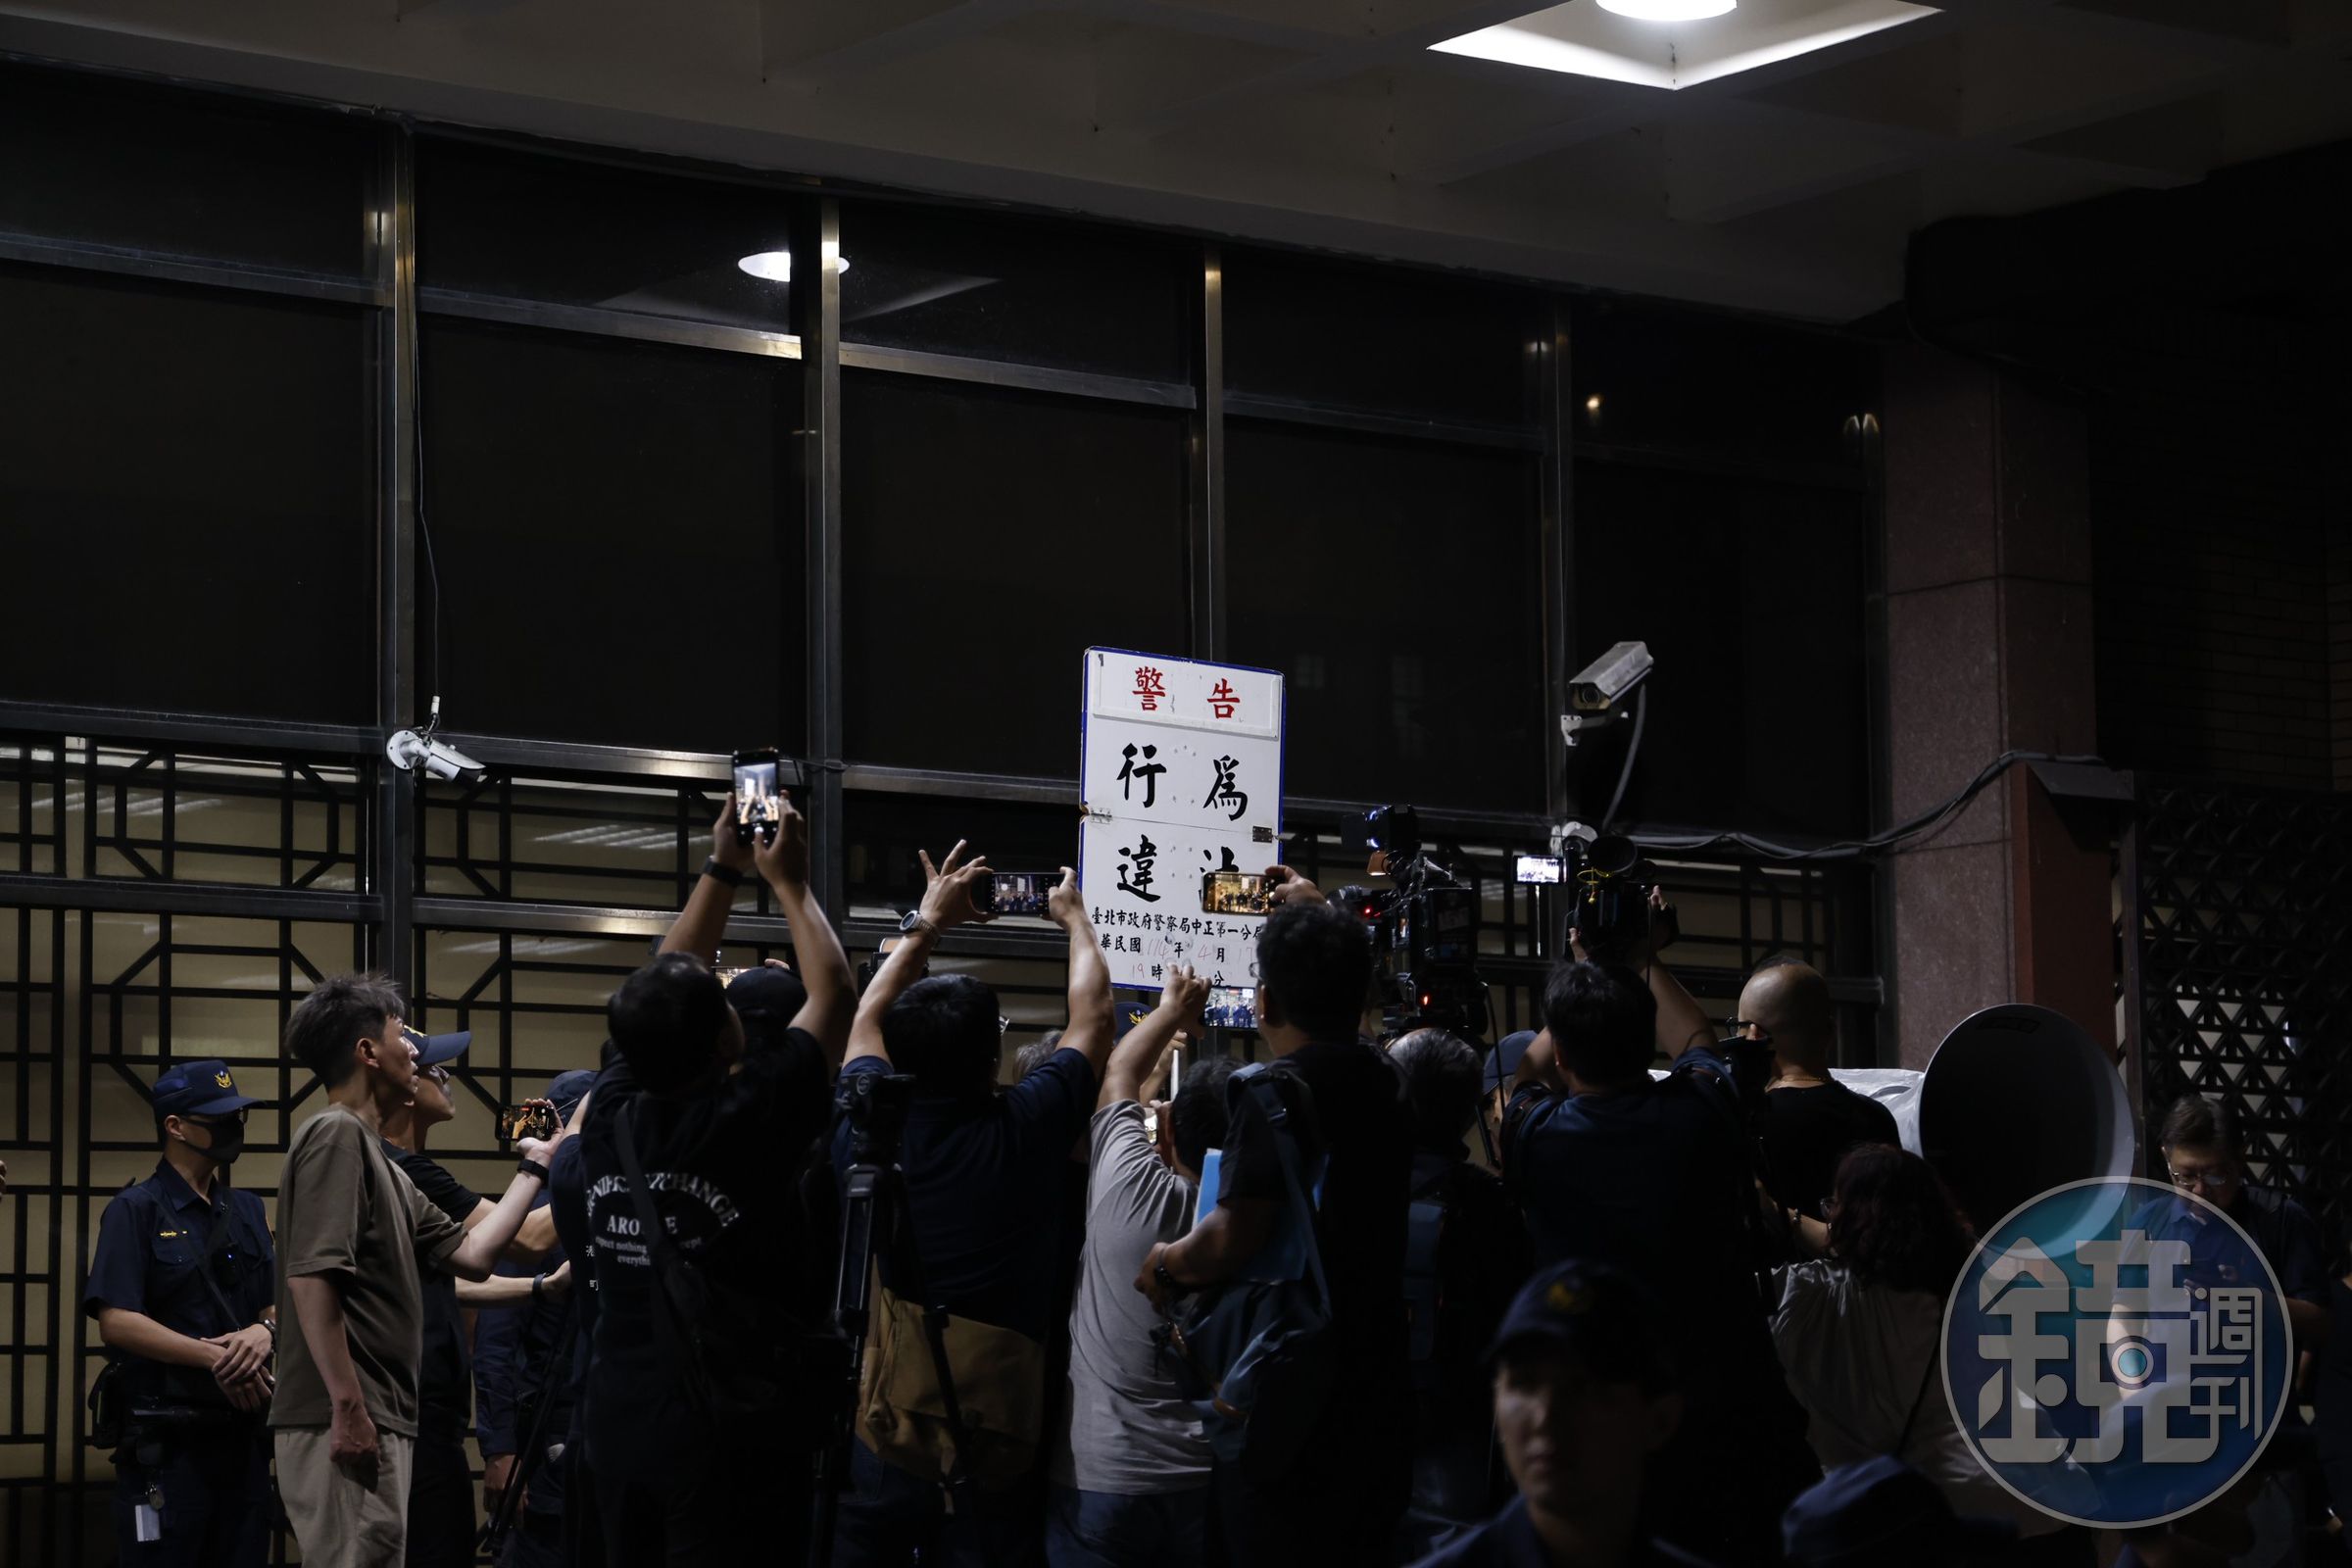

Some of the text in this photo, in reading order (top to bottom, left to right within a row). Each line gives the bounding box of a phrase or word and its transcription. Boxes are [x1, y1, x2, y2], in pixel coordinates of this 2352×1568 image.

[1132, 666, 1241, 719] 警告
[606, 1214, 678, 1236] AROE
[616, 1254, 652, 1267] everythi
